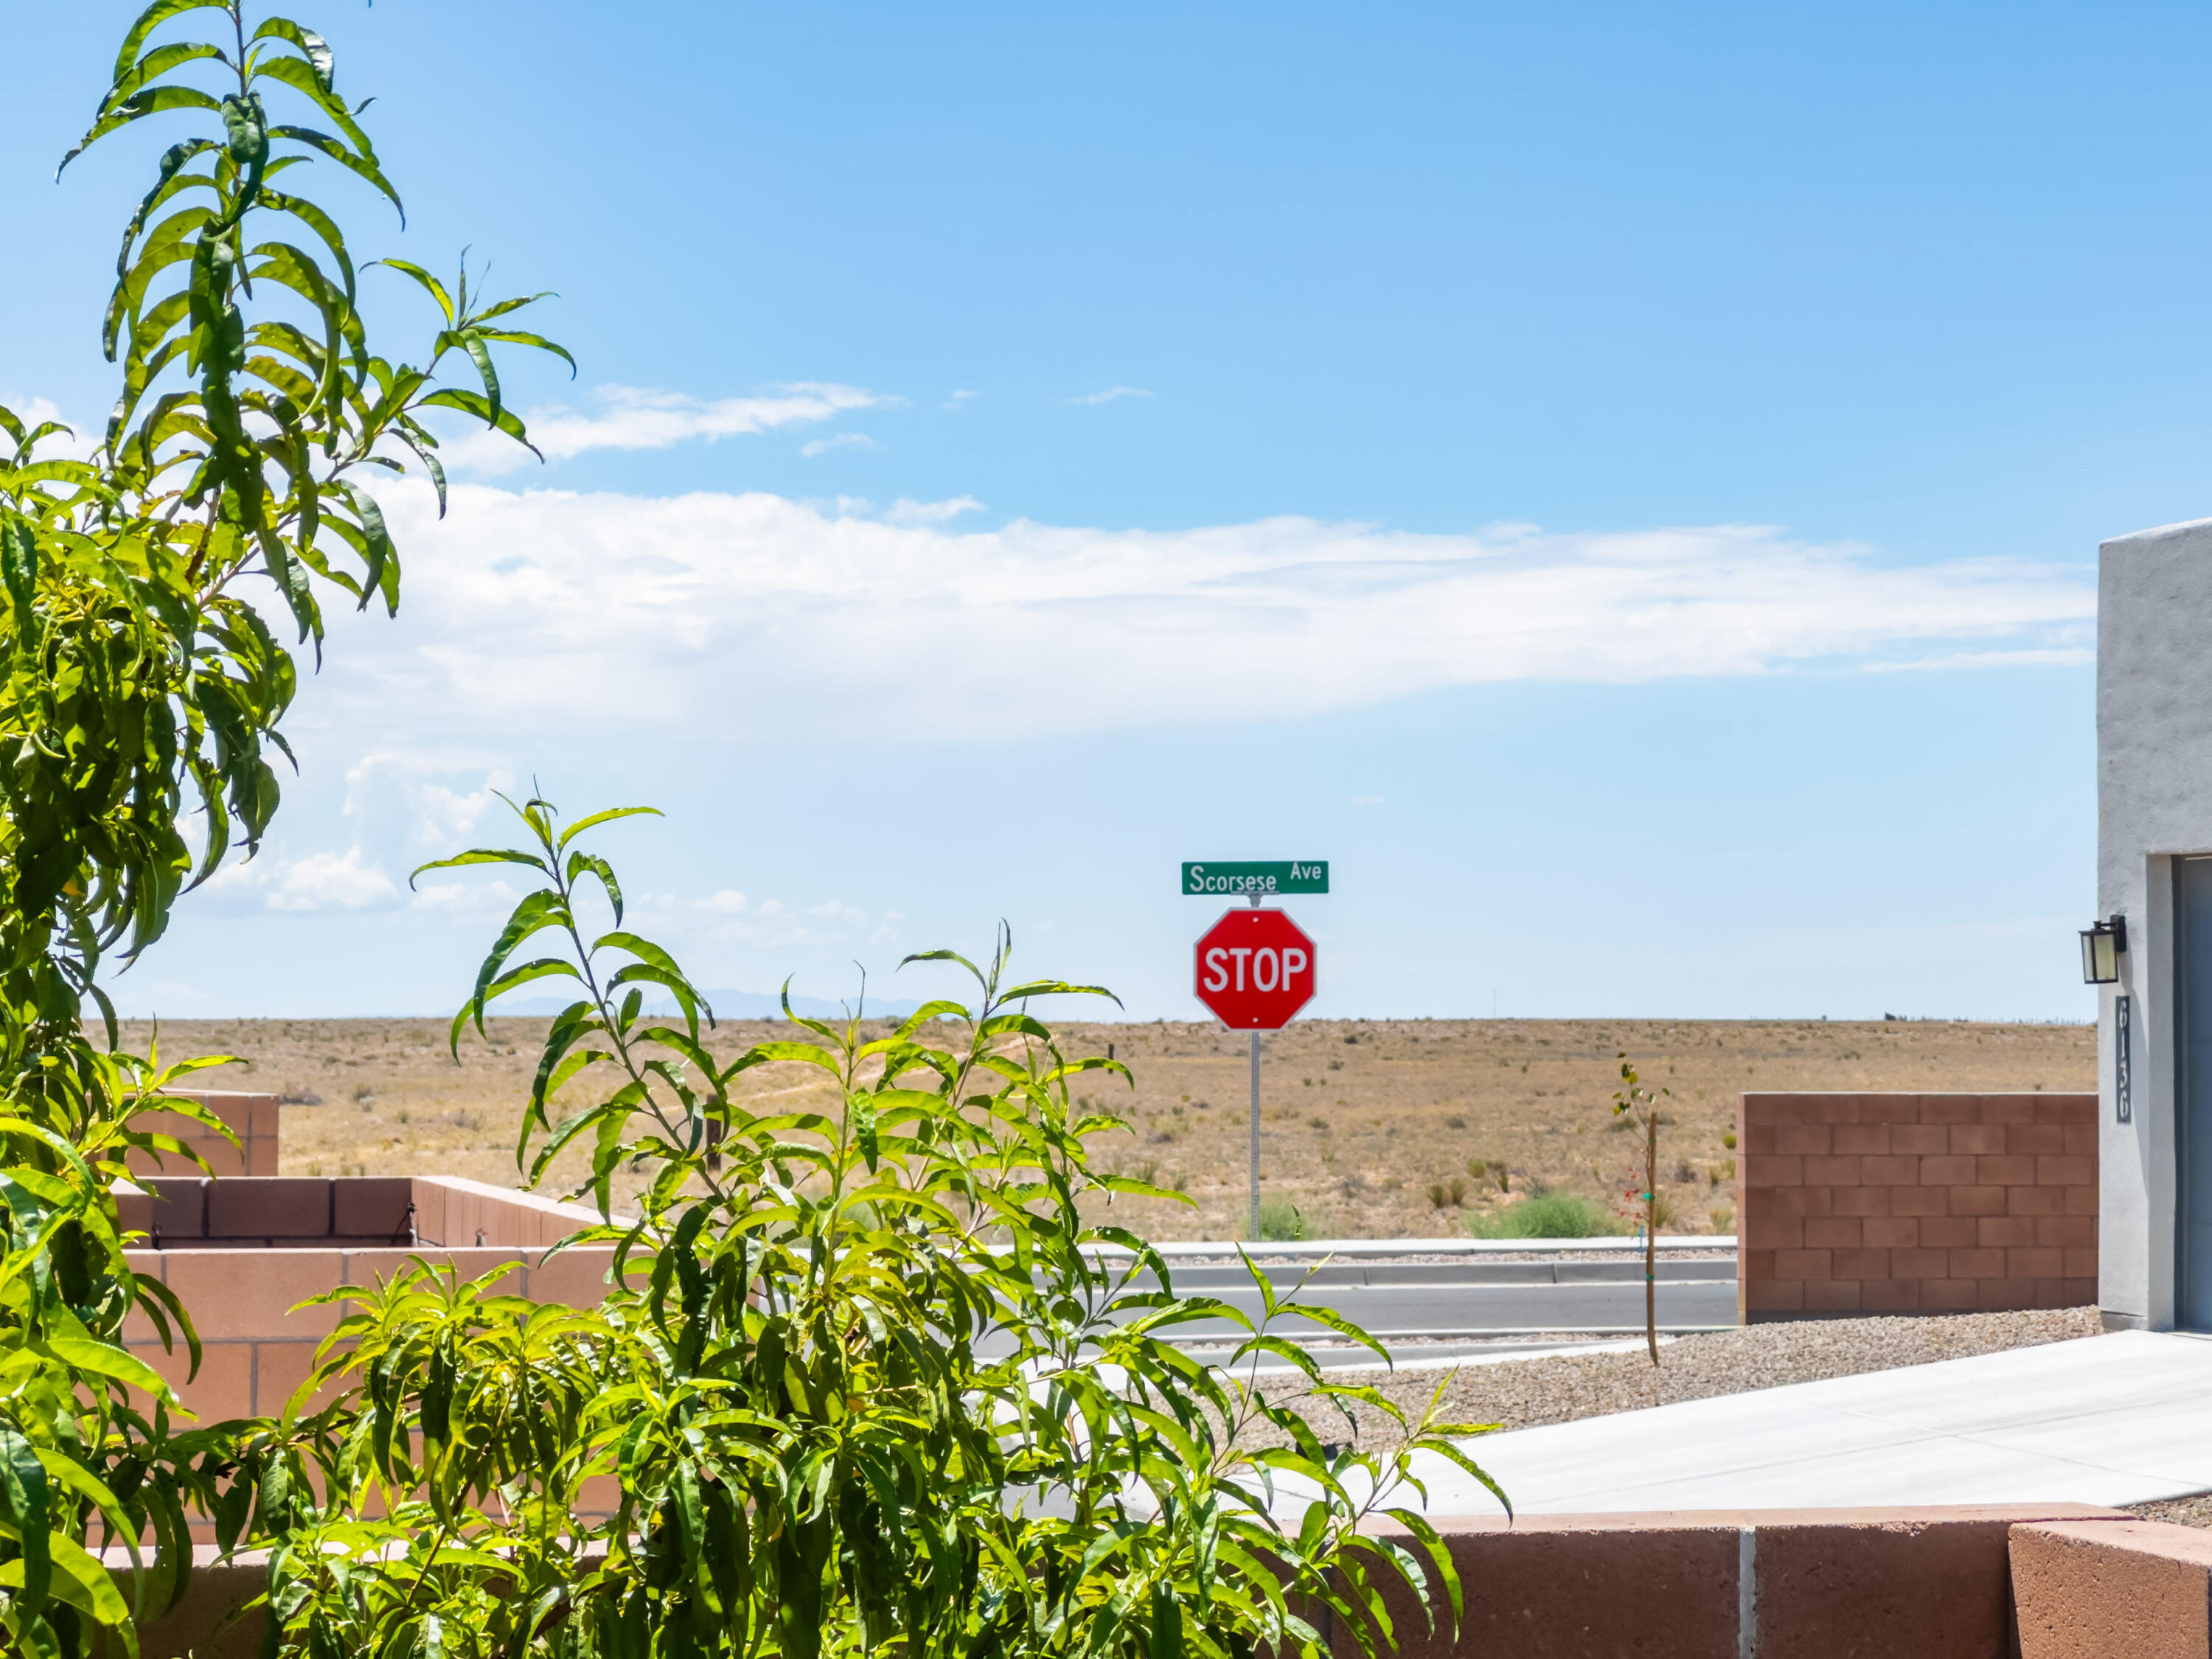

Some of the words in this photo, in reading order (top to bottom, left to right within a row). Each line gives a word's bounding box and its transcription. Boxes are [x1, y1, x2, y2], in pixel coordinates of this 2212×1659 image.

[1190, 865, 1277, 891] Scorsese
[1290, 861, 1322, 880] Ave
[1203, 947, 1307, 992] STOP
[2119, 1001, 2129, 1119] 6136
